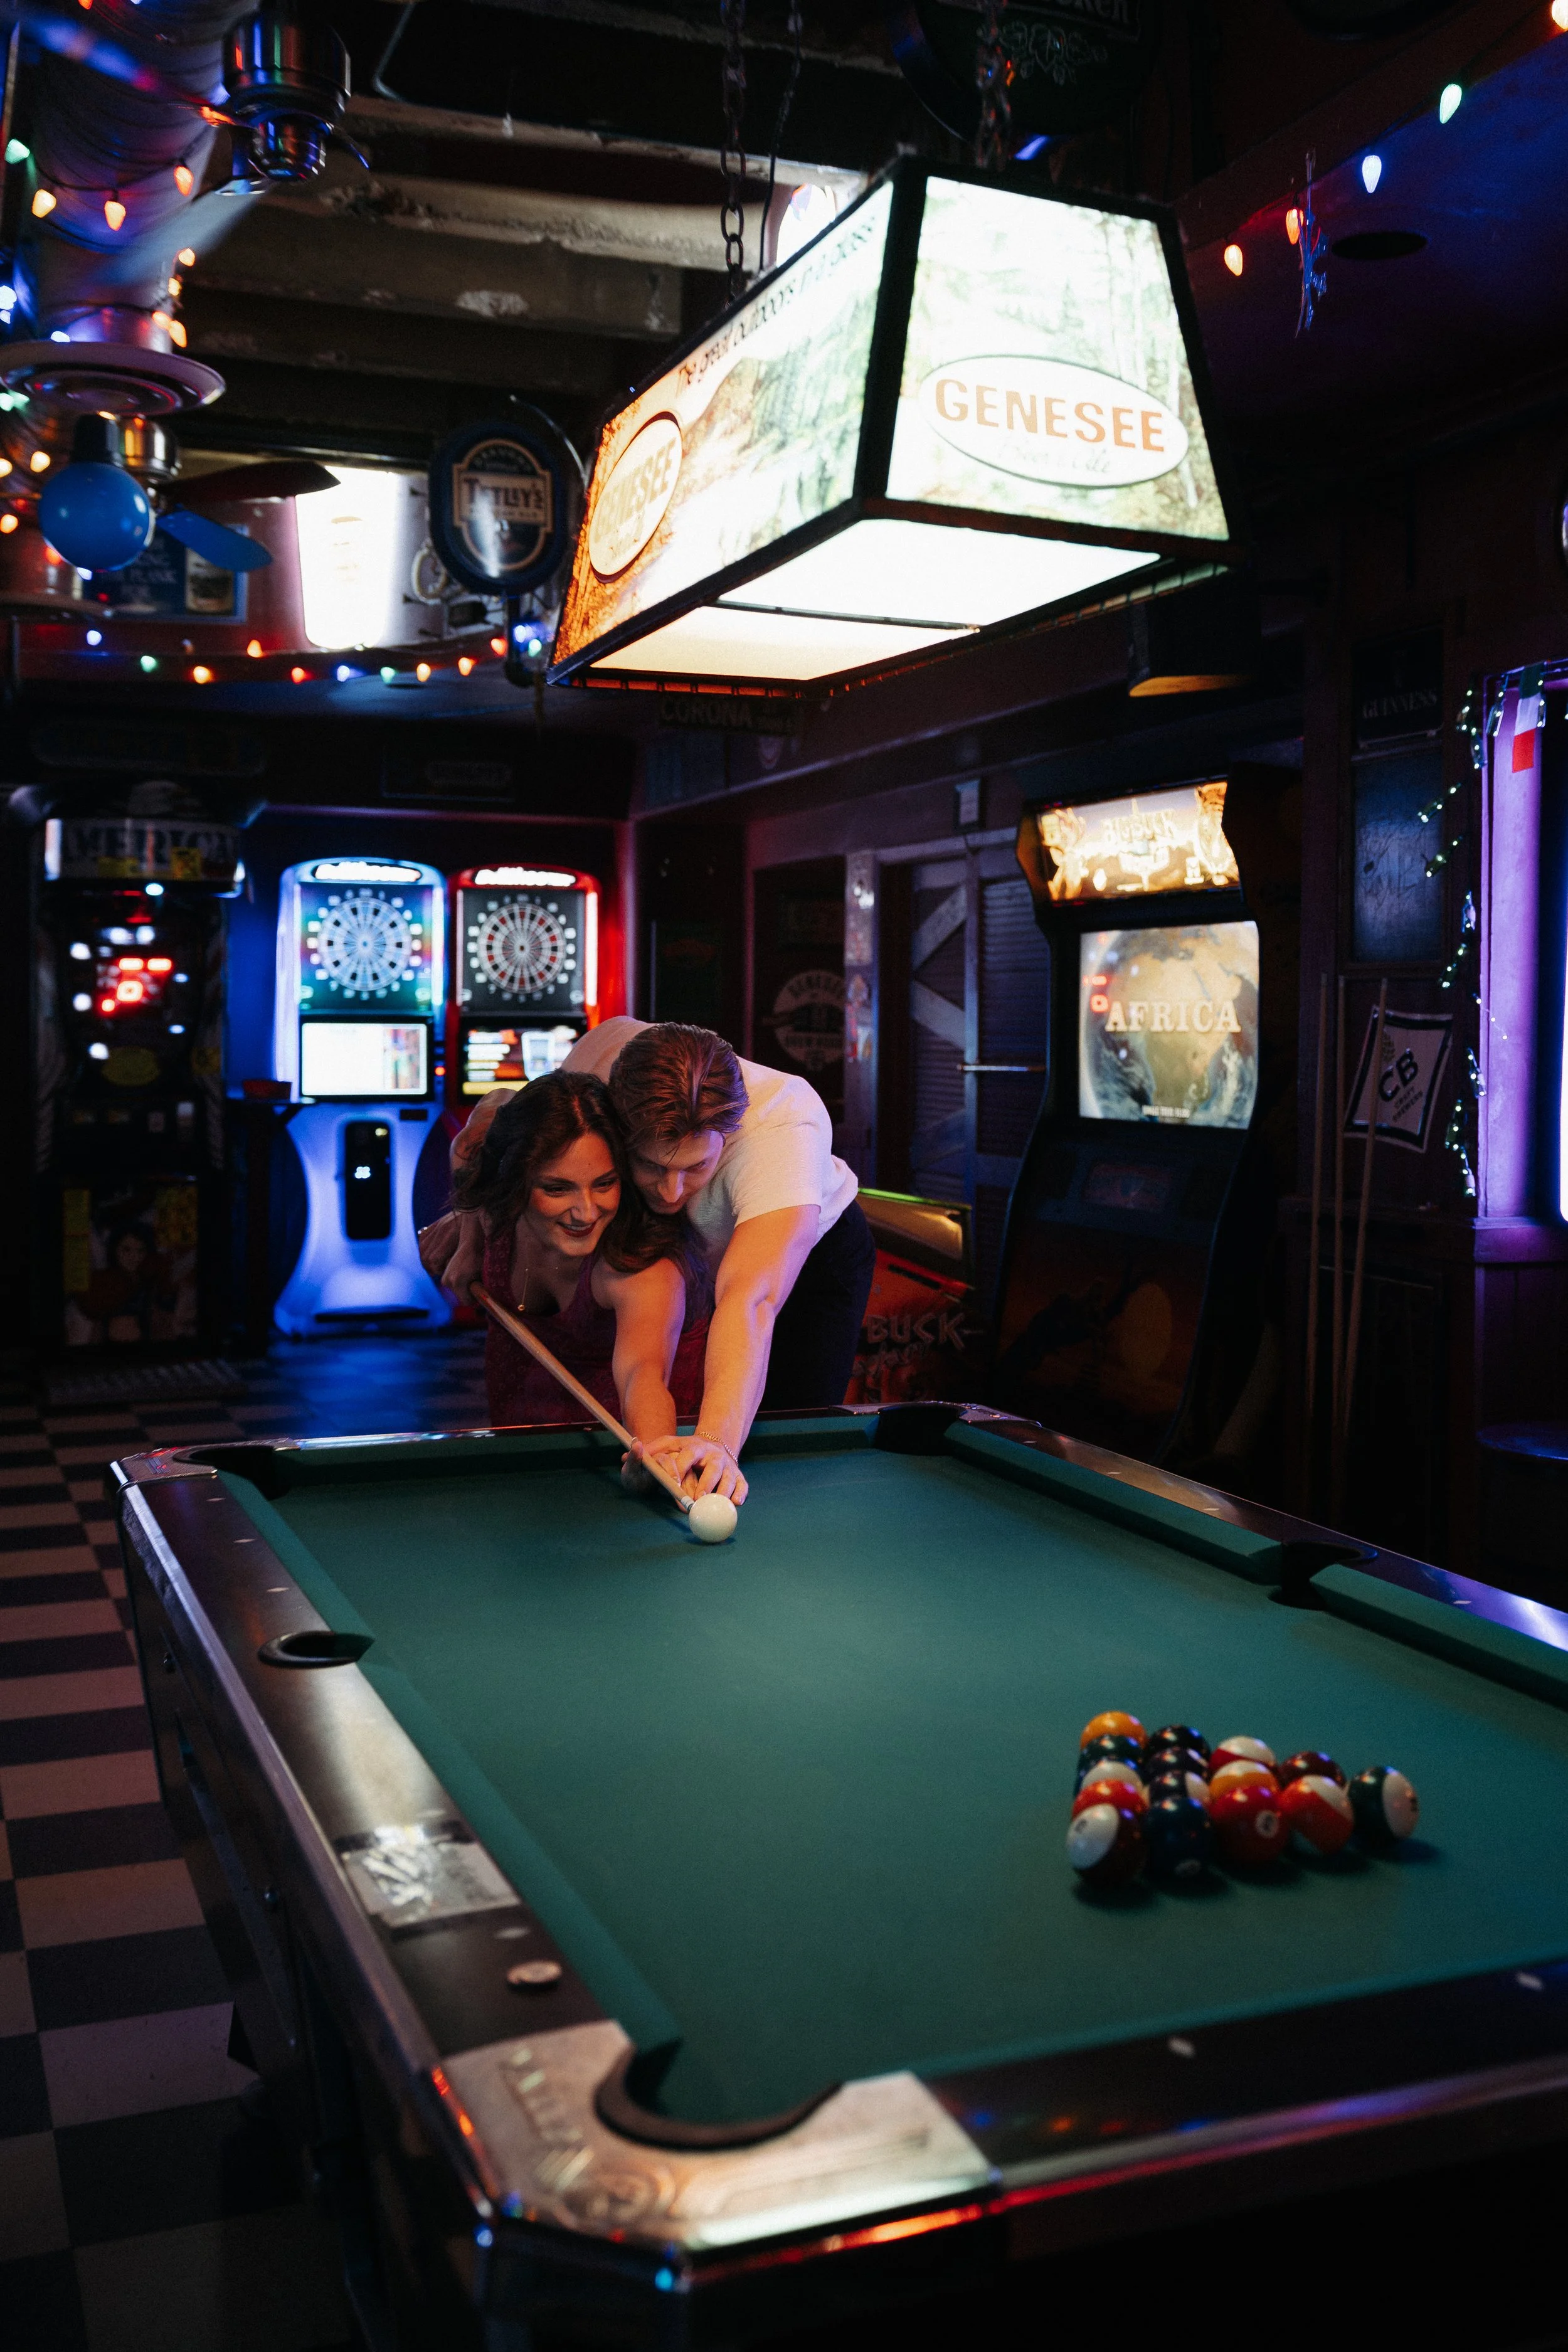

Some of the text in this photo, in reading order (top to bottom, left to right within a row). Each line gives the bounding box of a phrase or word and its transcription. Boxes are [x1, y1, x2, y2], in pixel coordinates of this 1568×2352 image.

[935, 378, 1166, 453] GENESEE
[1104, 1001, 1242, 1032] AFRICA
[1379, 1048, 1418, 1102] CB
[867, 1311, 966, 1350] BUCK
